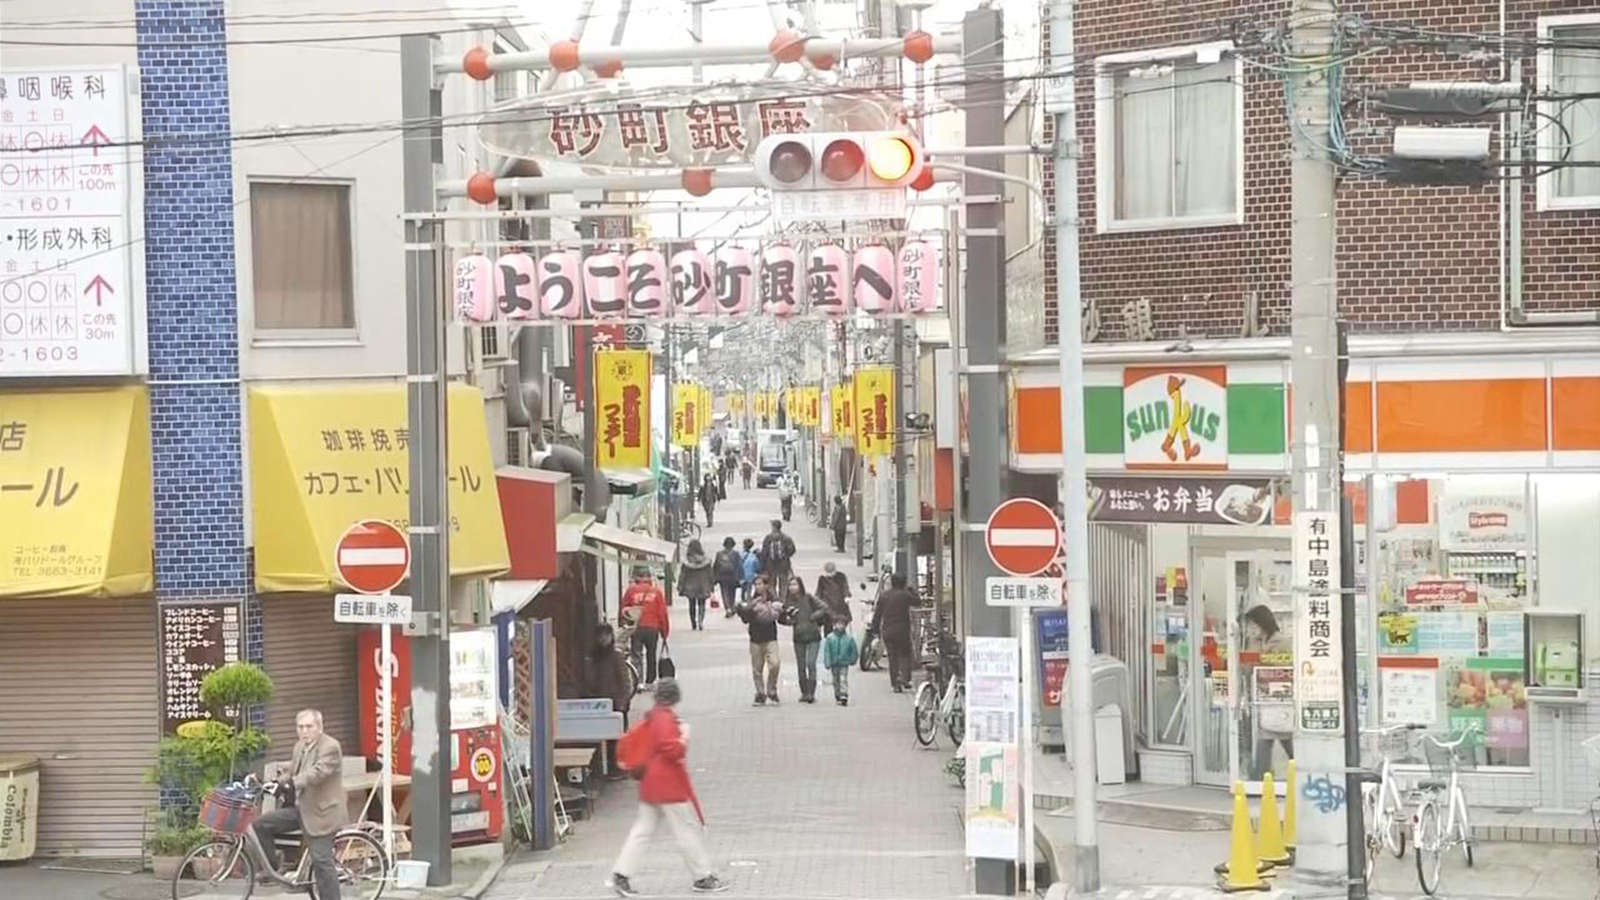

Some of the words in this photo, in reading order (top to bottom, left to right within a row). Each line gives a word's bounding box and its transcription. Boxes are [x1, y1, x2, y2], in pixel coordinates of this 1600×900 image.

[27, 109, 39, 122] 土
[53, 108, 64, 121] 日
[547, 99, 812, 158] 砂町銀座
[79, 164, 114, 176] この先
[79, 179, 116, 191] 100m
[499, 257, 894, 312] ようこそ砂町銀座へ
[82, 313, 117, 326] この先
[85, 328, 115, 340] 30m
[1153, 486, 1213, 514] お弁当
[14, 567, 31, 576] TEL
[991, 584, 1057, 600] 自転車を除く
[1308, 518, 1331, 657] 有中島塗料商会
[340, 601, 407, 618] 自転車を除く
[167, 680, 204, 688] クリームソー
[167, 696, 199, 704] ホットドッ
